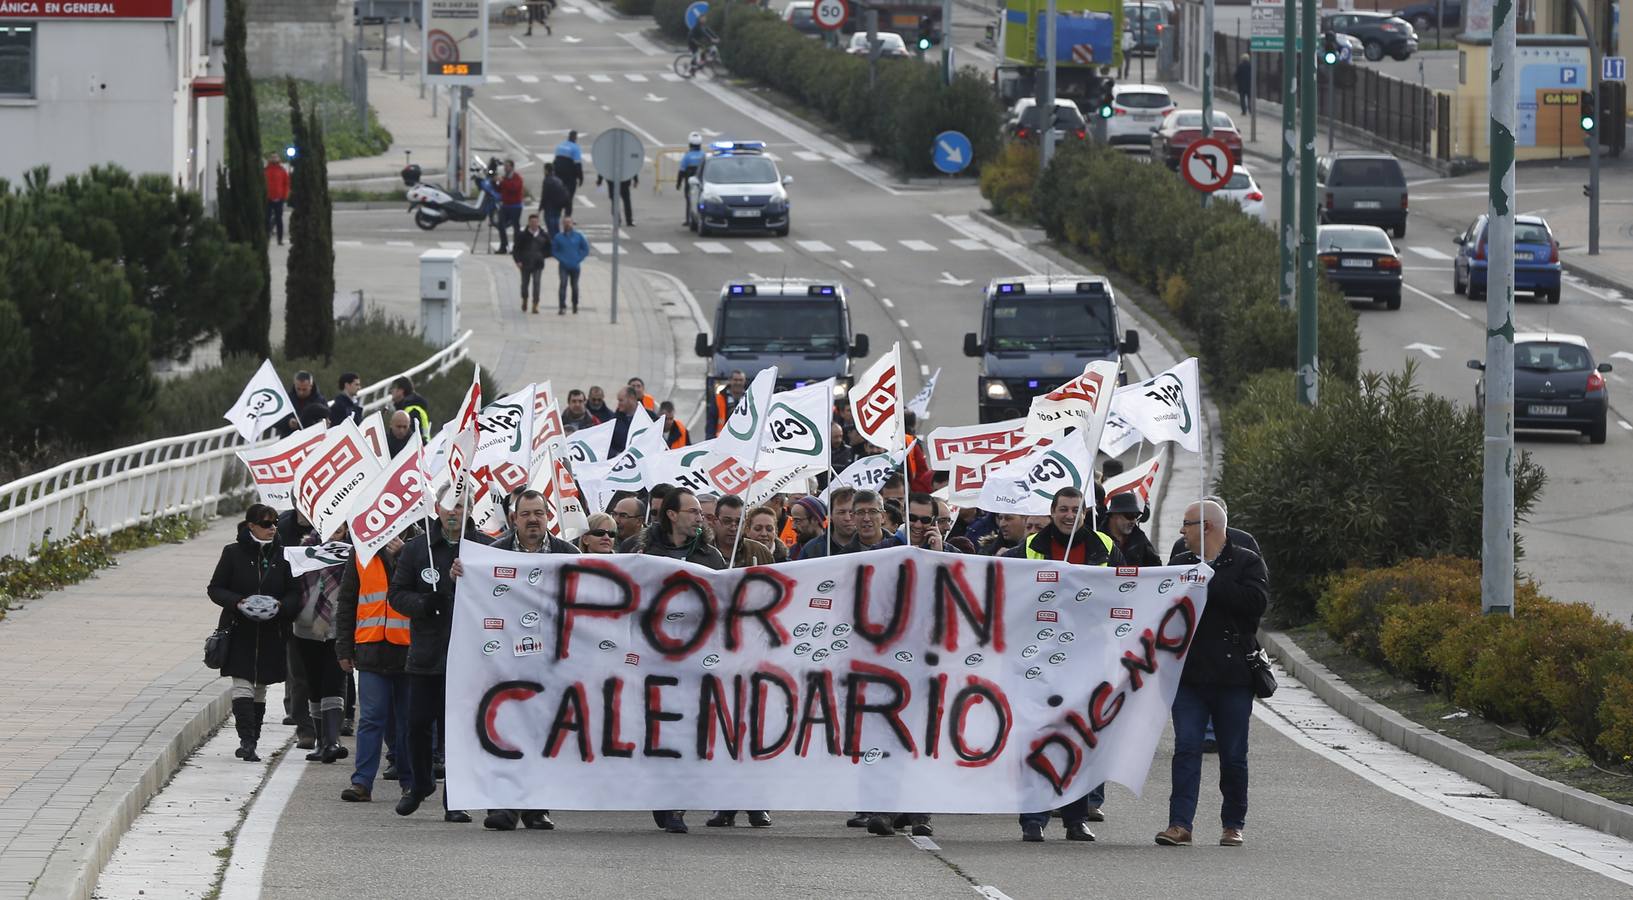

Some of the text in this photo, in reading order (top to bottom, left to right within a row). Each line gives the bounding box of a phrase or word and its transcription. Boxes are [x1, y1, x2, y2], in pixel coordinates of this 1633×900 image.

[45, 3, 60, 13] EN
[63, 3, 115, 13] GENERAL
[821, 5, 840, 17] 50
[1563, 69, 1575, 82] P
[555, 558, 1006, 662] POR UN
[476, 595, 1196, 796] CALENDARIO DIGNO
